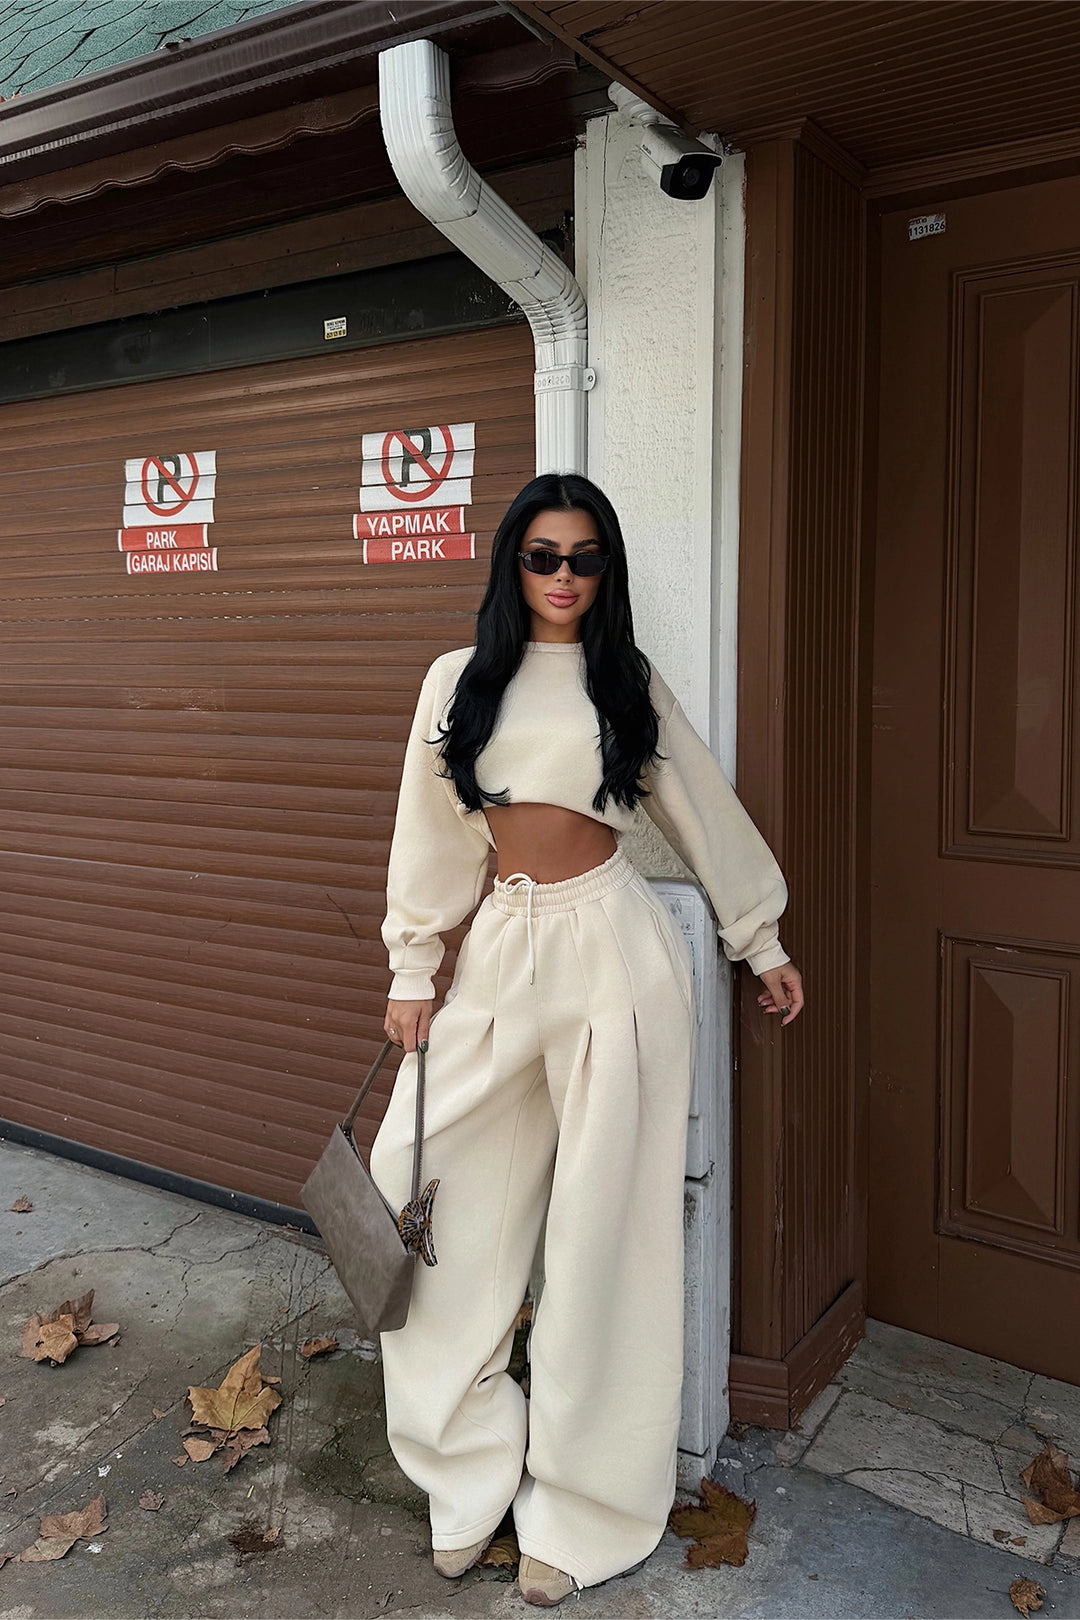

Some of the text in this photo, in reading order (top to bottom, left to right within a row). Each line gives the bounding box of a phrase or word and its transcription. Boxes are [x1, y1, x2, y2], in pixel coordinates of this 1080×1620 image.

[366, 511, 451, 536] YAPMAK
[146, 530, 179, 550] PARK
[391, 538, 446, 561] PARK
[131, 552, 212, 572] GARAJ KAPISI
